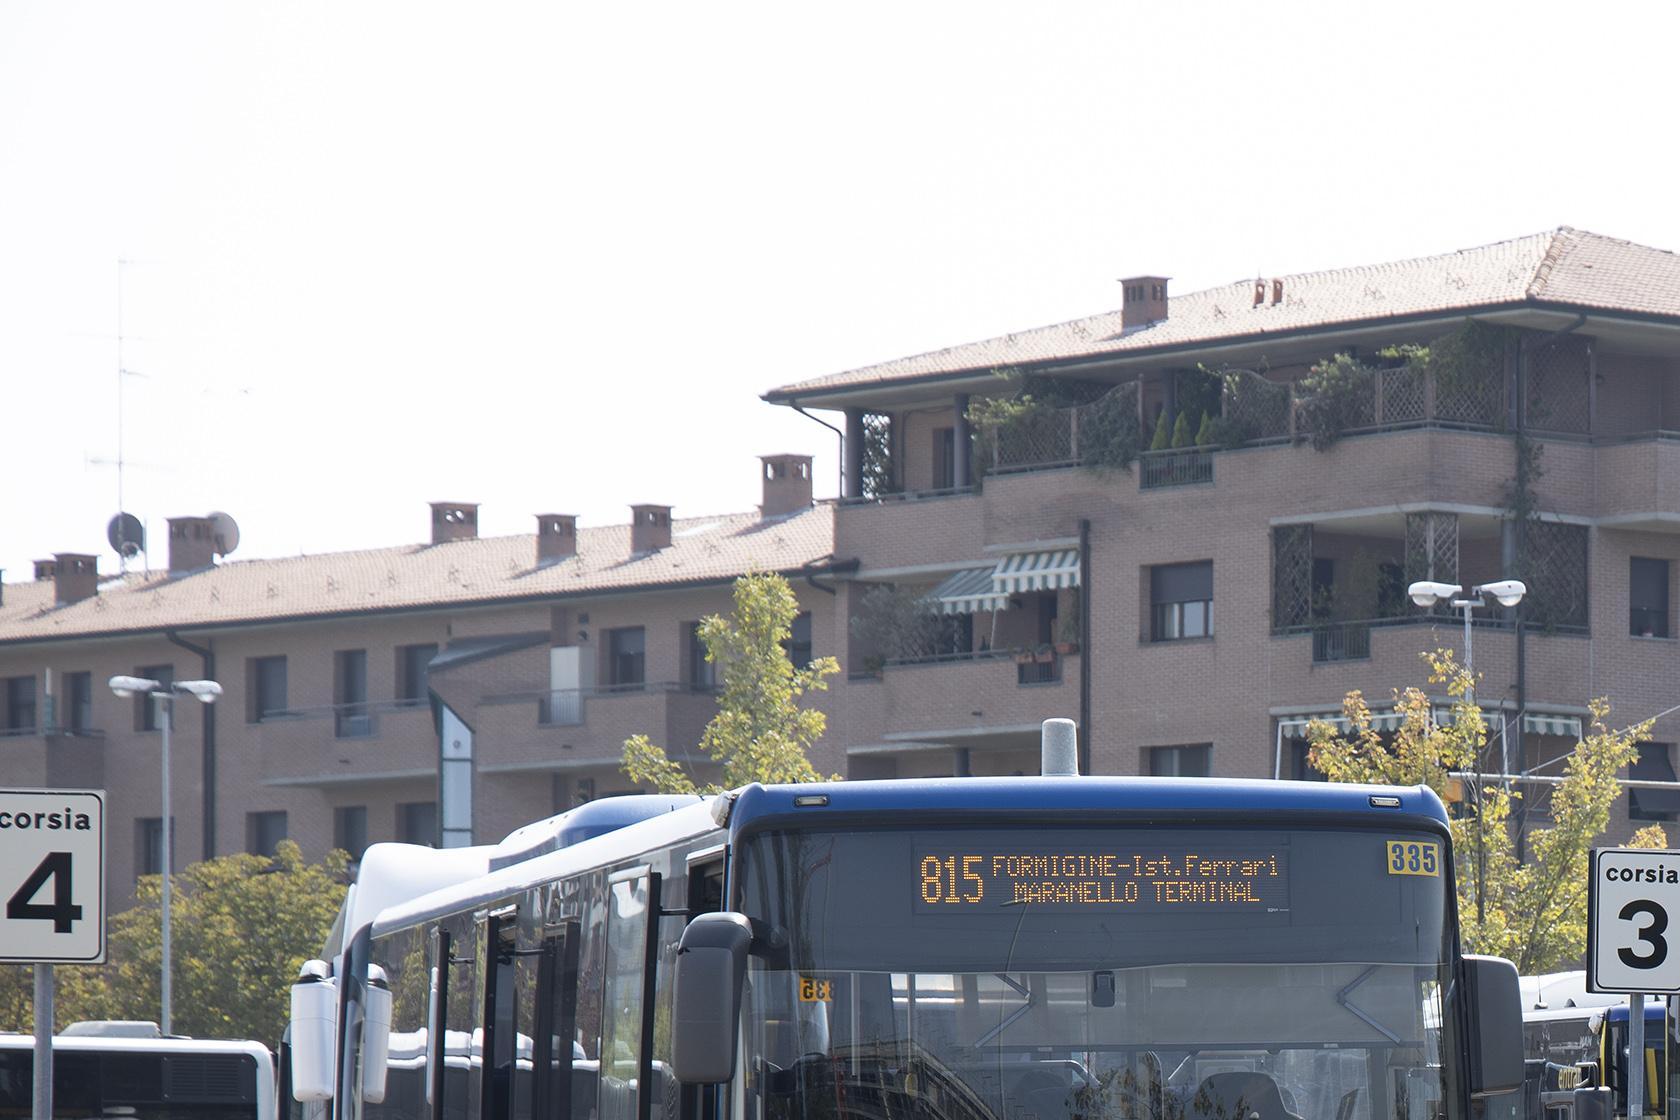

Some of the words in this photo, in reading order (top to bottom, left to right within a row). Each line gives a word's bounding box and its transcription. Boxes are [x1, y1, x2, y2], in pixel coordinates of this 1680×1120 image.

[0, 807, 91, 830] corsia
[1391, 844, 1436, 873] 335
[920, 856, 984, 903] 815
[993, 855, 1279, 877] FORMIGINE-Ist.Ferrari
[1605, 864, 1679, 884] corsia
[6, 852, 82, 933] 4
[1014, 881, 1139, 903] MARANELLO
[1152, 881, 1260, 902] TERMINAL
[1617, 899, 1669, 970] 3
